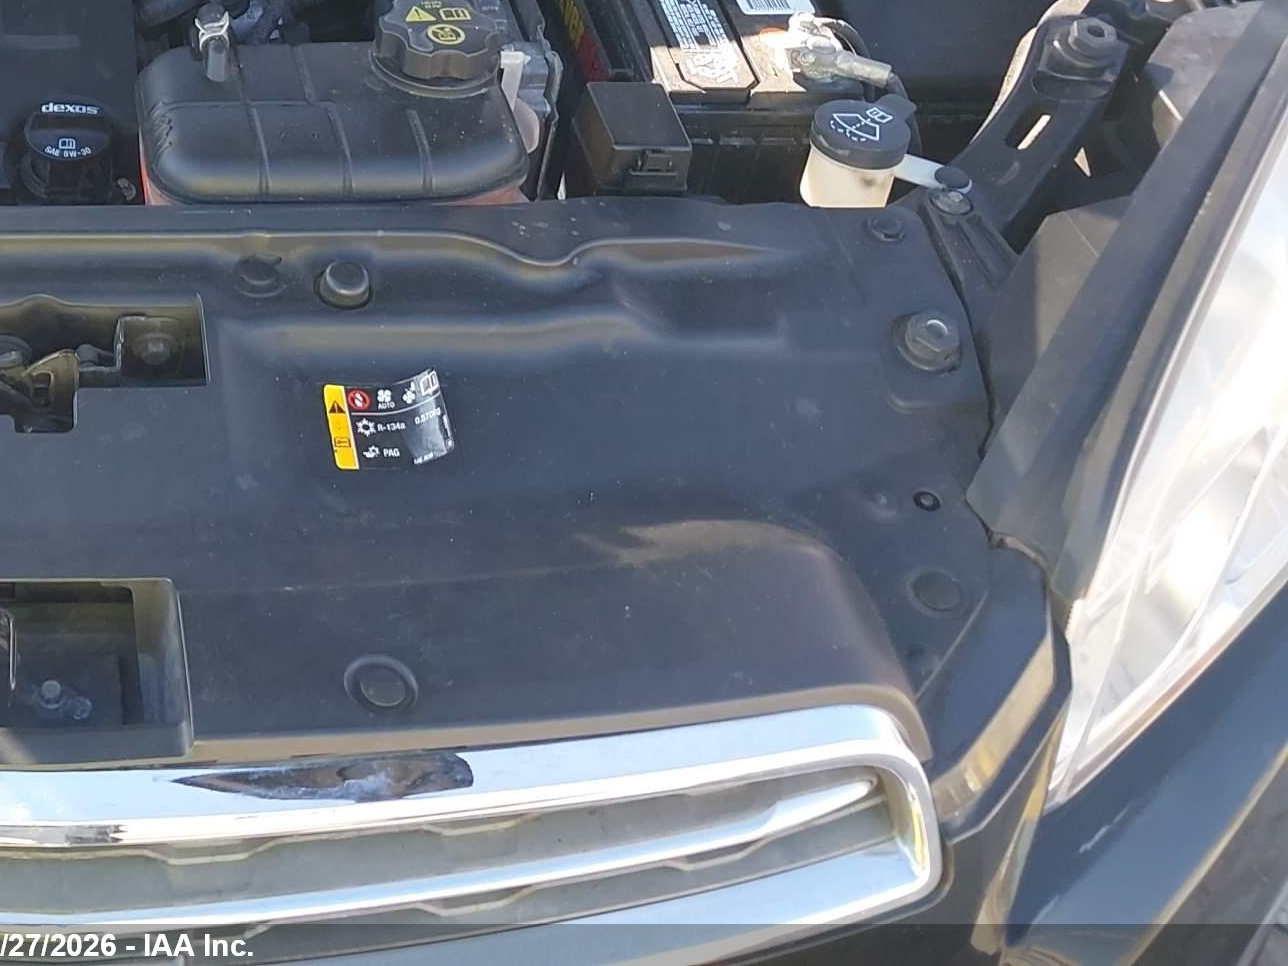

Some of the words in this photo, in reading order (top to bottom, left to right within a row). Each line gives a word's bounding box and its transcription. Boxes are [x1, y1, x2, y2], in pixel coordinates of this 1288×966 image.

[378, 401, 395, 410] AUTO
[377, 421, 406, 432] R-134a
[383, 447, 400, 458] PAG
